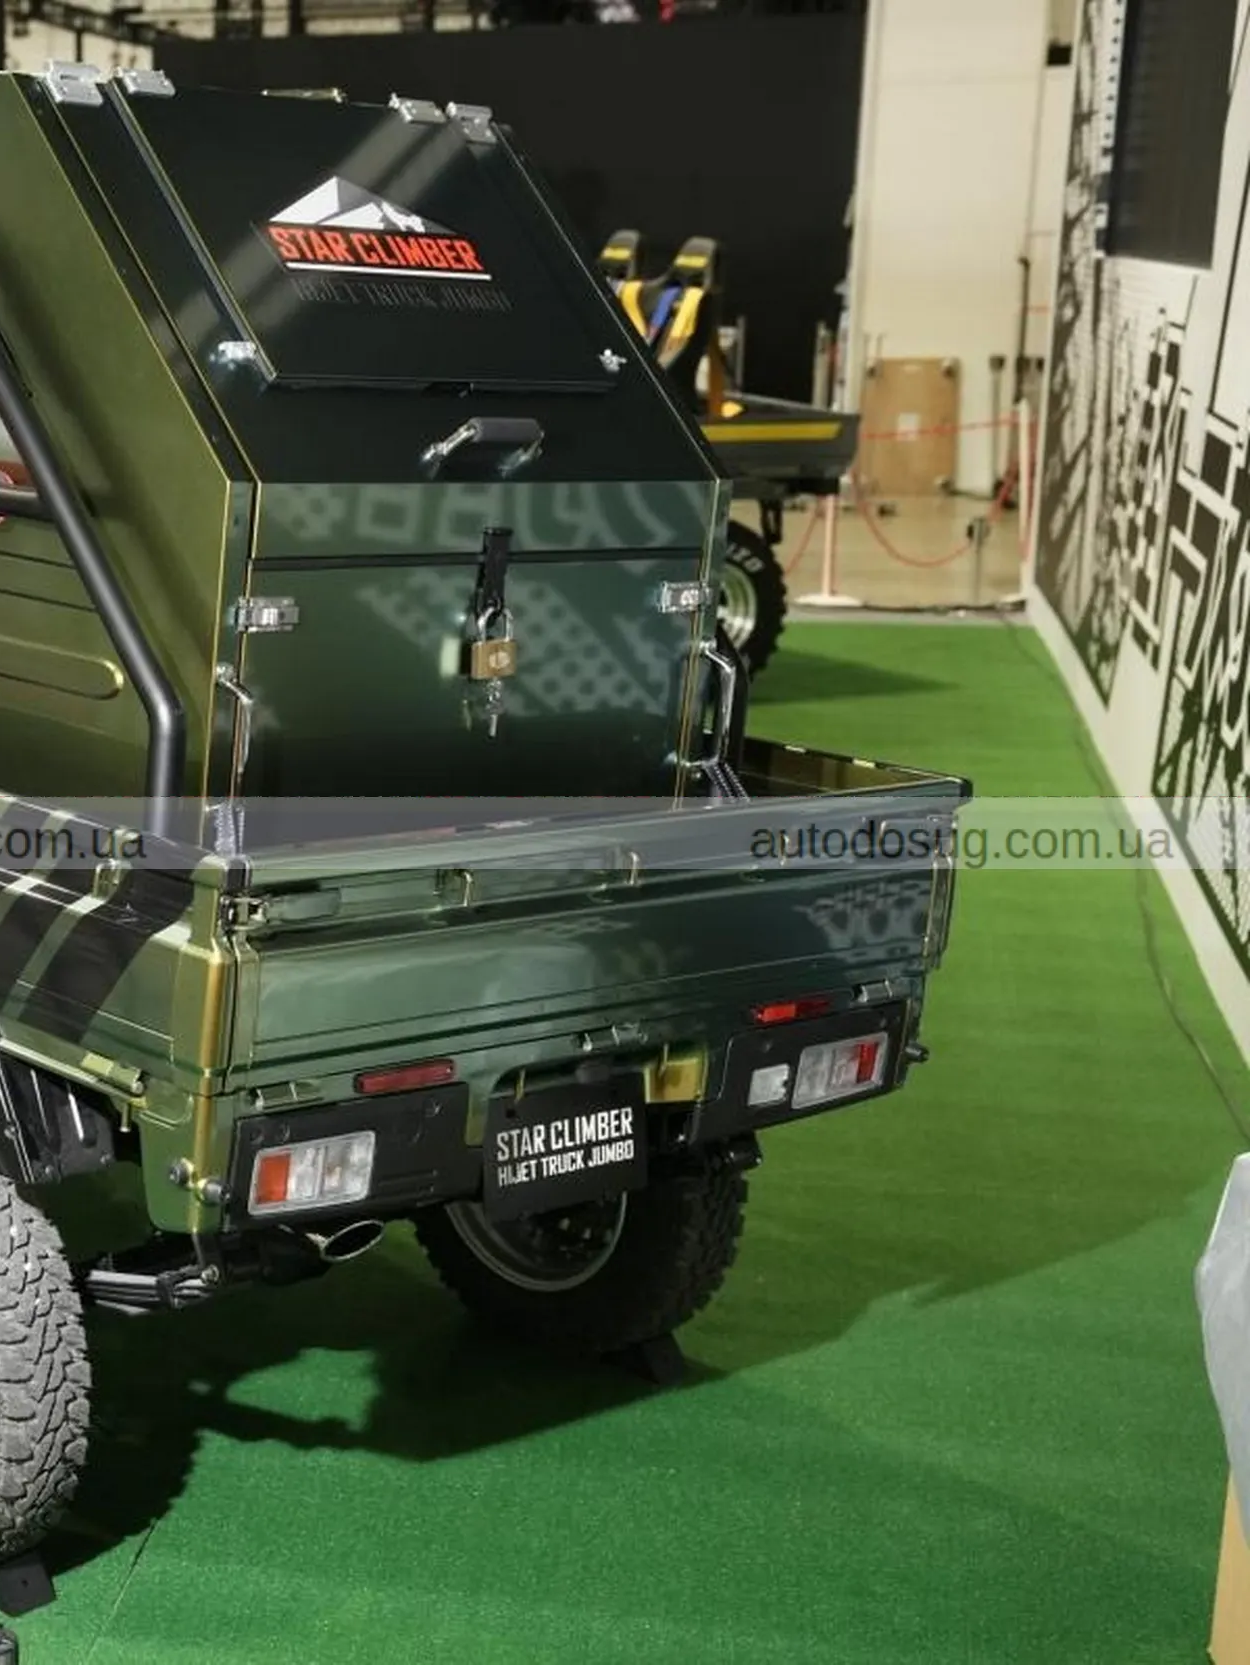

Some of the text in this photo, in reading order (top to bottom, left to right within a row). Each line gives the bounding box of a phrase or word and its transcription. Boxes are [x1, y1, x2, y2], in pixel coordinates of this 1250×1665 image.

[268, 226, 484, 271] STAR CLIMBER
[497, 1107, 634, 1161] STAR CLIMBER
[498, 1139, 635, 1187] HIJET TRUCK JUMBO
